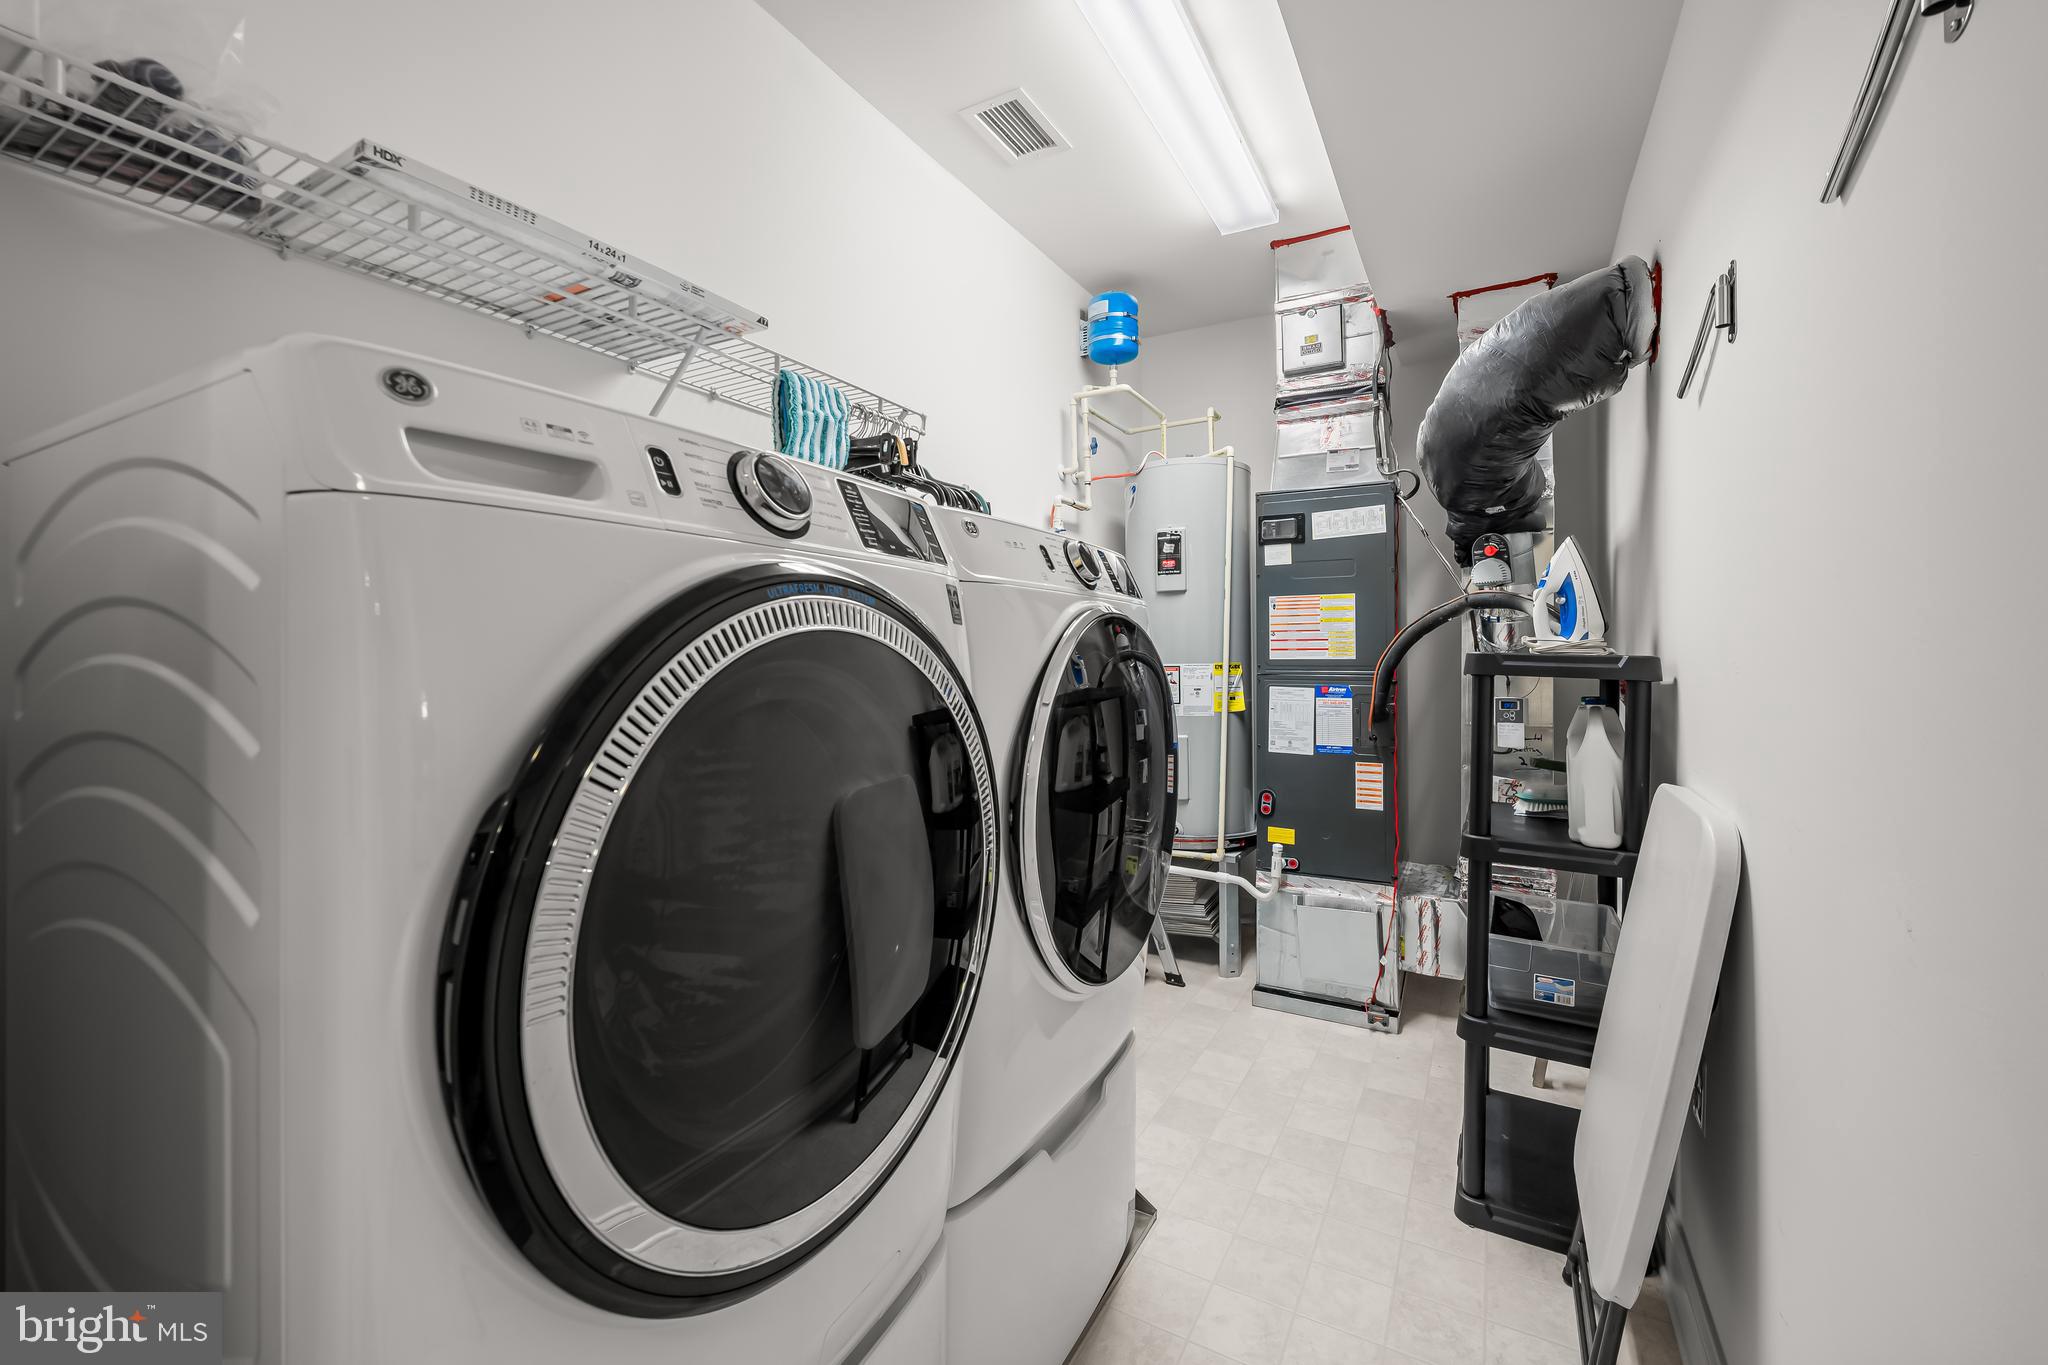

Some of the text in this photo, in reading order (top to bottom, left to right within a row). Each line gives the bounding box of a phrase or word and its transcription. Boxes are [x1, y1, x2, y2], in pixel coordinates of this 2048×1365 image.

[373, 145, 403, 167] HDX
[767, 583, 877, 605] ULTRAFRESH VENT SYSTEM
